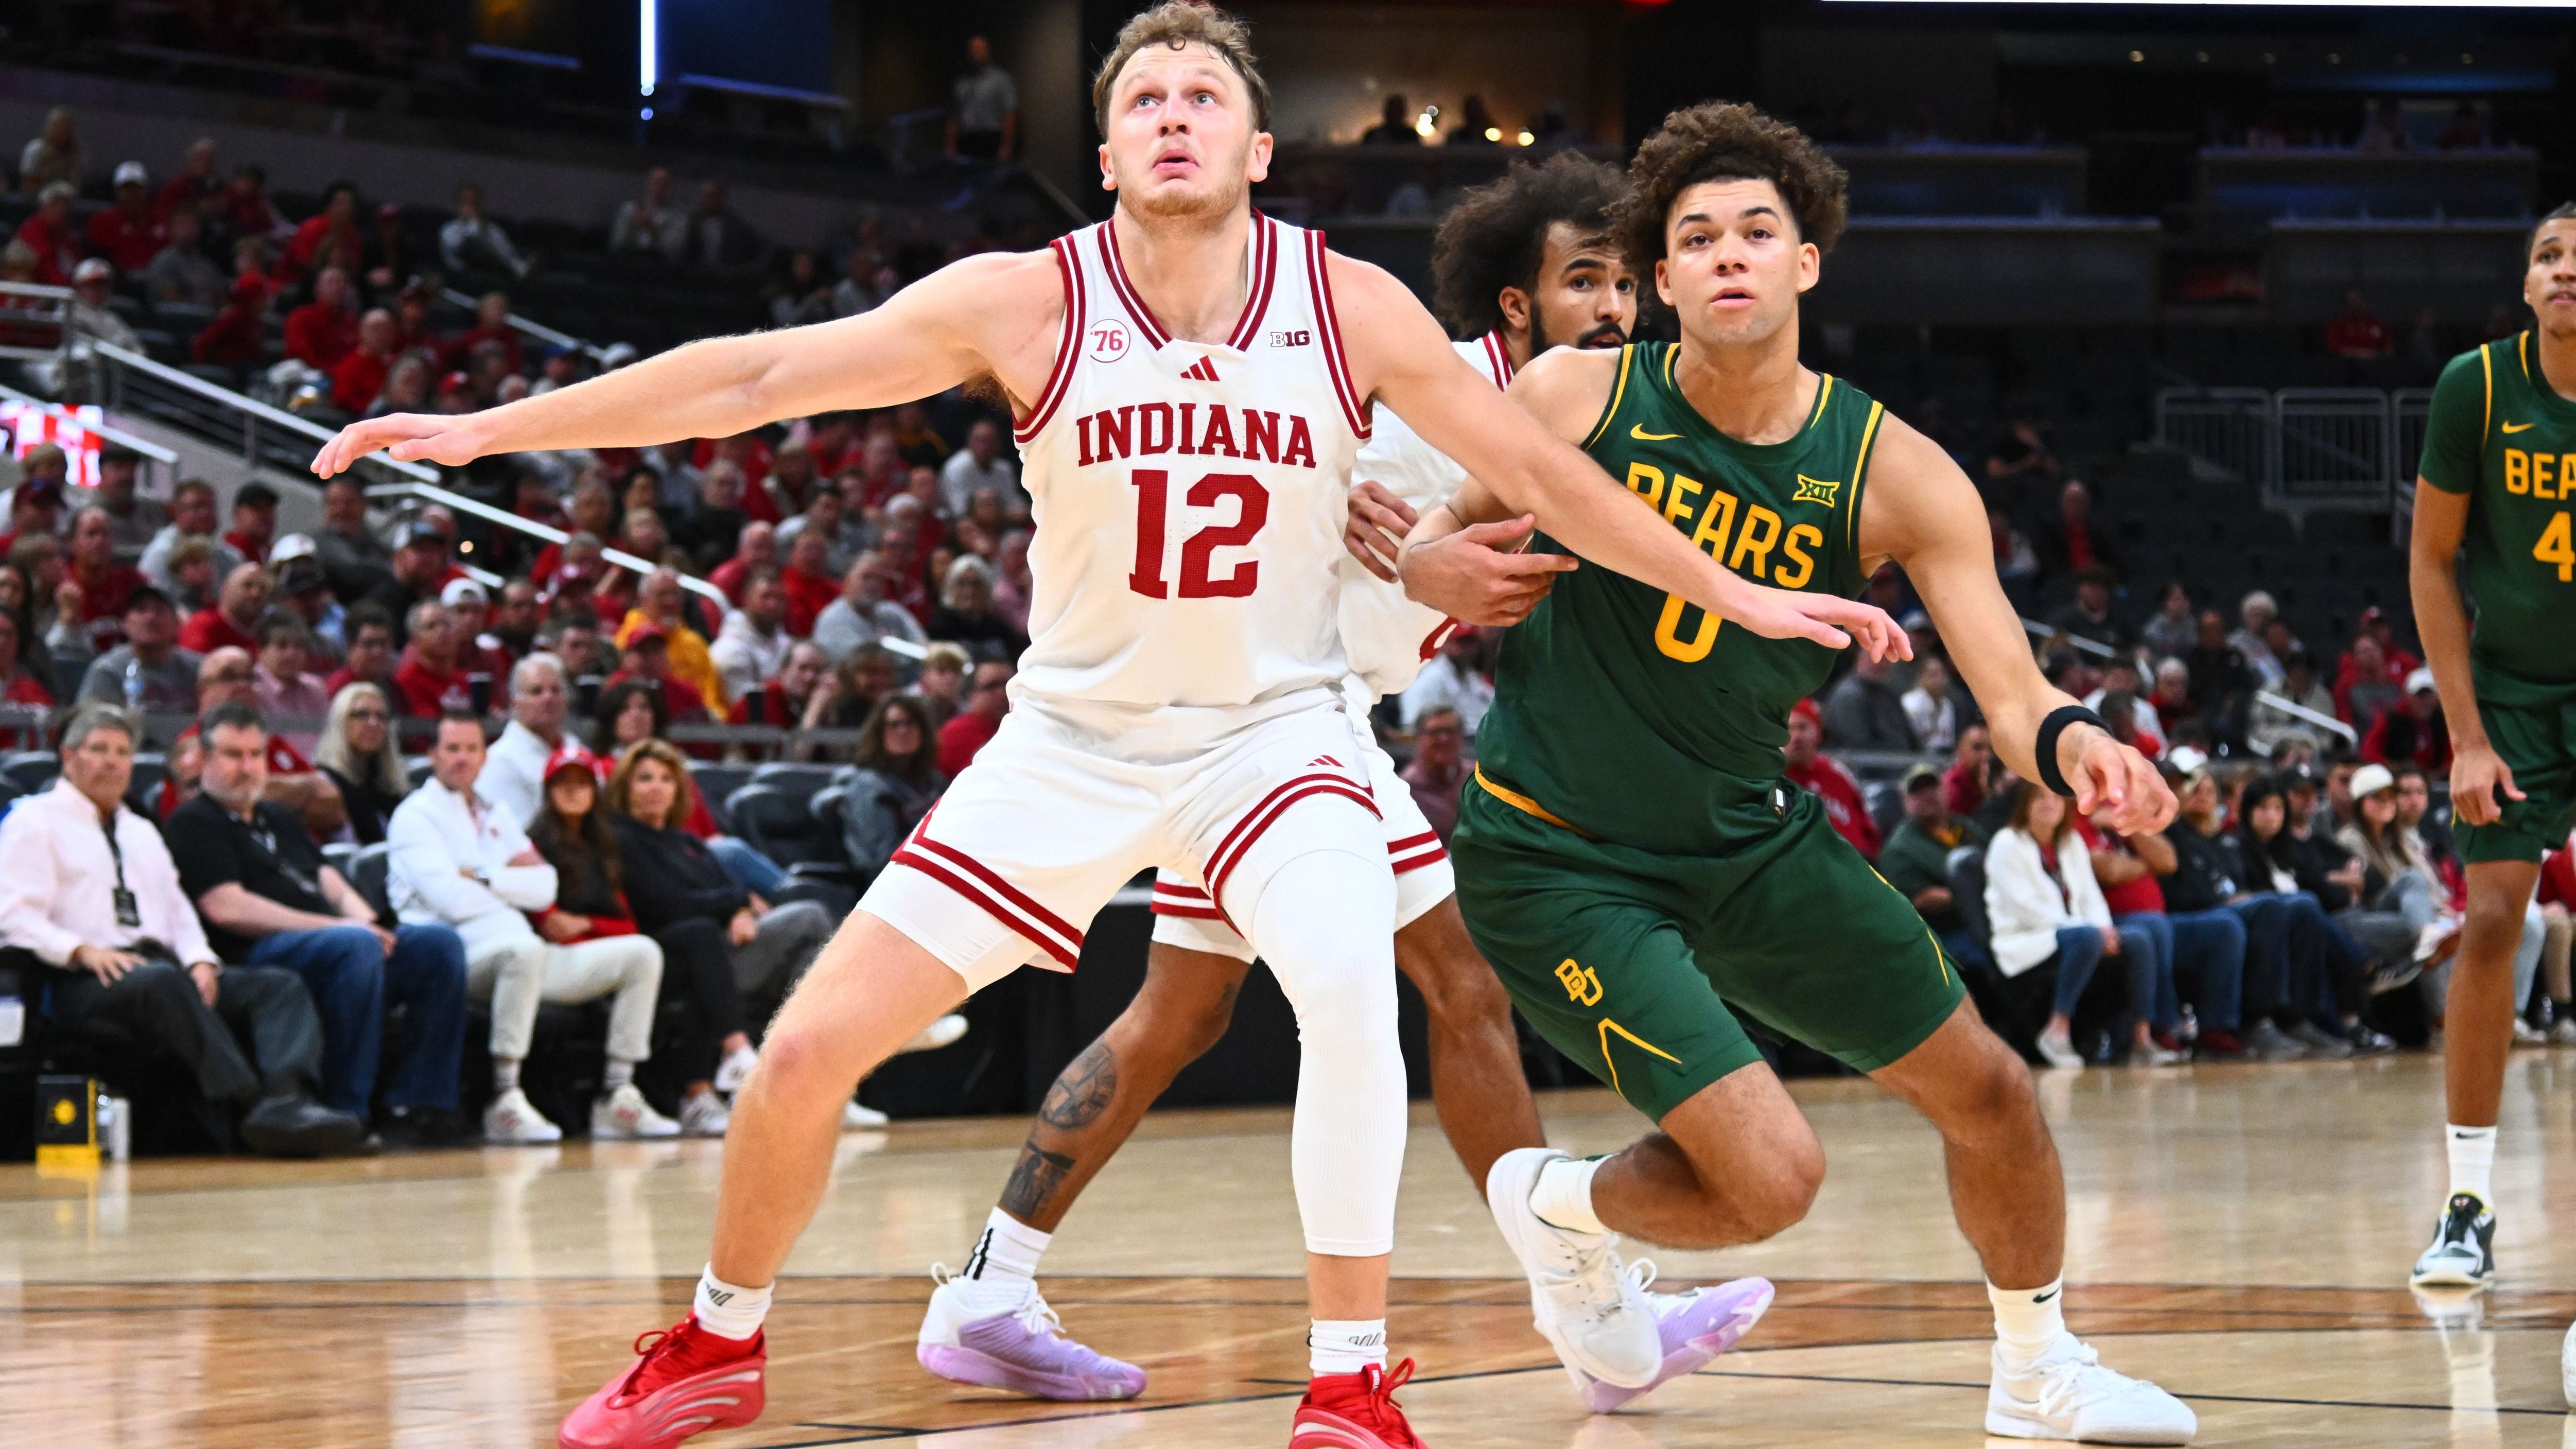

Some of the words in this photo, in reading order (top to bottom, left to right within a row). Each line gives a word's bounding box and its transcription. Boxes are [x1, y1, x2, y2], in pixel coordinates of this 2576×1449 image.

[1076, 402, 1317, 469] INDIANA
[1129, 469, 1269, 600] 12
[2533, 511, 2575, 582] 4
[1554, 958, 1603, 1006] BU
